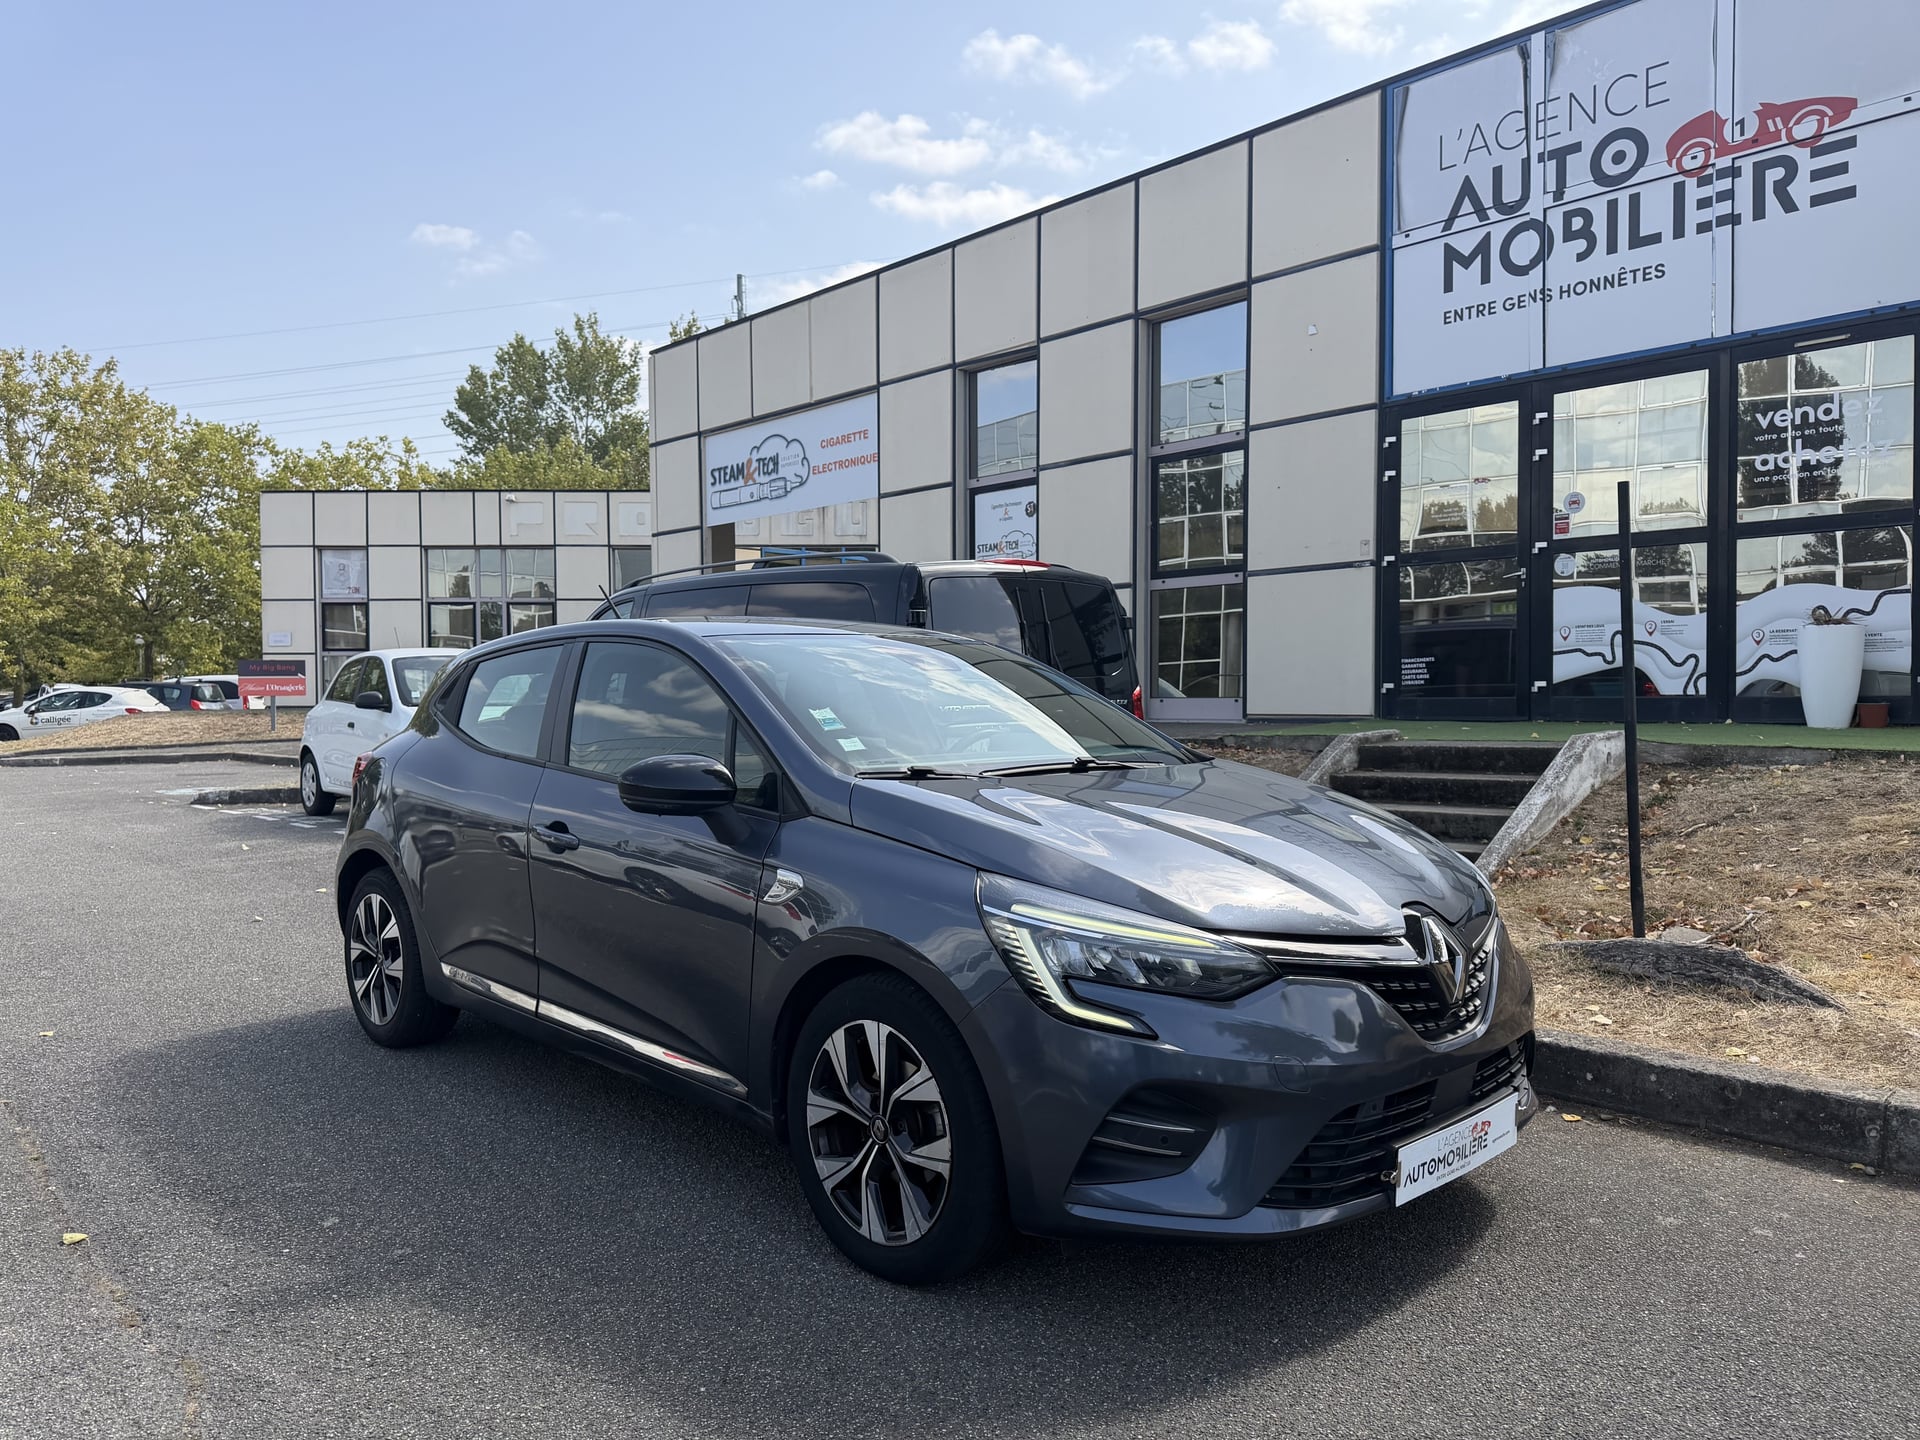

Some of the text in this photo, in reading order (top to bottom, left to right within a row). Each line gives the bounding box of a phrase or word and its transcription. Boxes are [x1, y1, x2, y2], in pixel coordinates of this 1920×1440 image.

[1440, 61, 1670, 171] L'AGENCE
[1734, 117, 1746, 138] 1
[1440, 127, 1650, 233] AUTO
[1443, 263, 1667, 326] ENTRE GENS HONNÊTES
[1755, 391, 1884, 430] vendez
[820, 429, 869, 449] CIGARETTE
[1754, 432, 1778, 442] votre
[1804, 428, 1817, 436] en
[812, 452, 878, 475] ELECTRONIQUE
[1753, 475, 1770, 483] une
[40, 715, 72, 726] calligée
